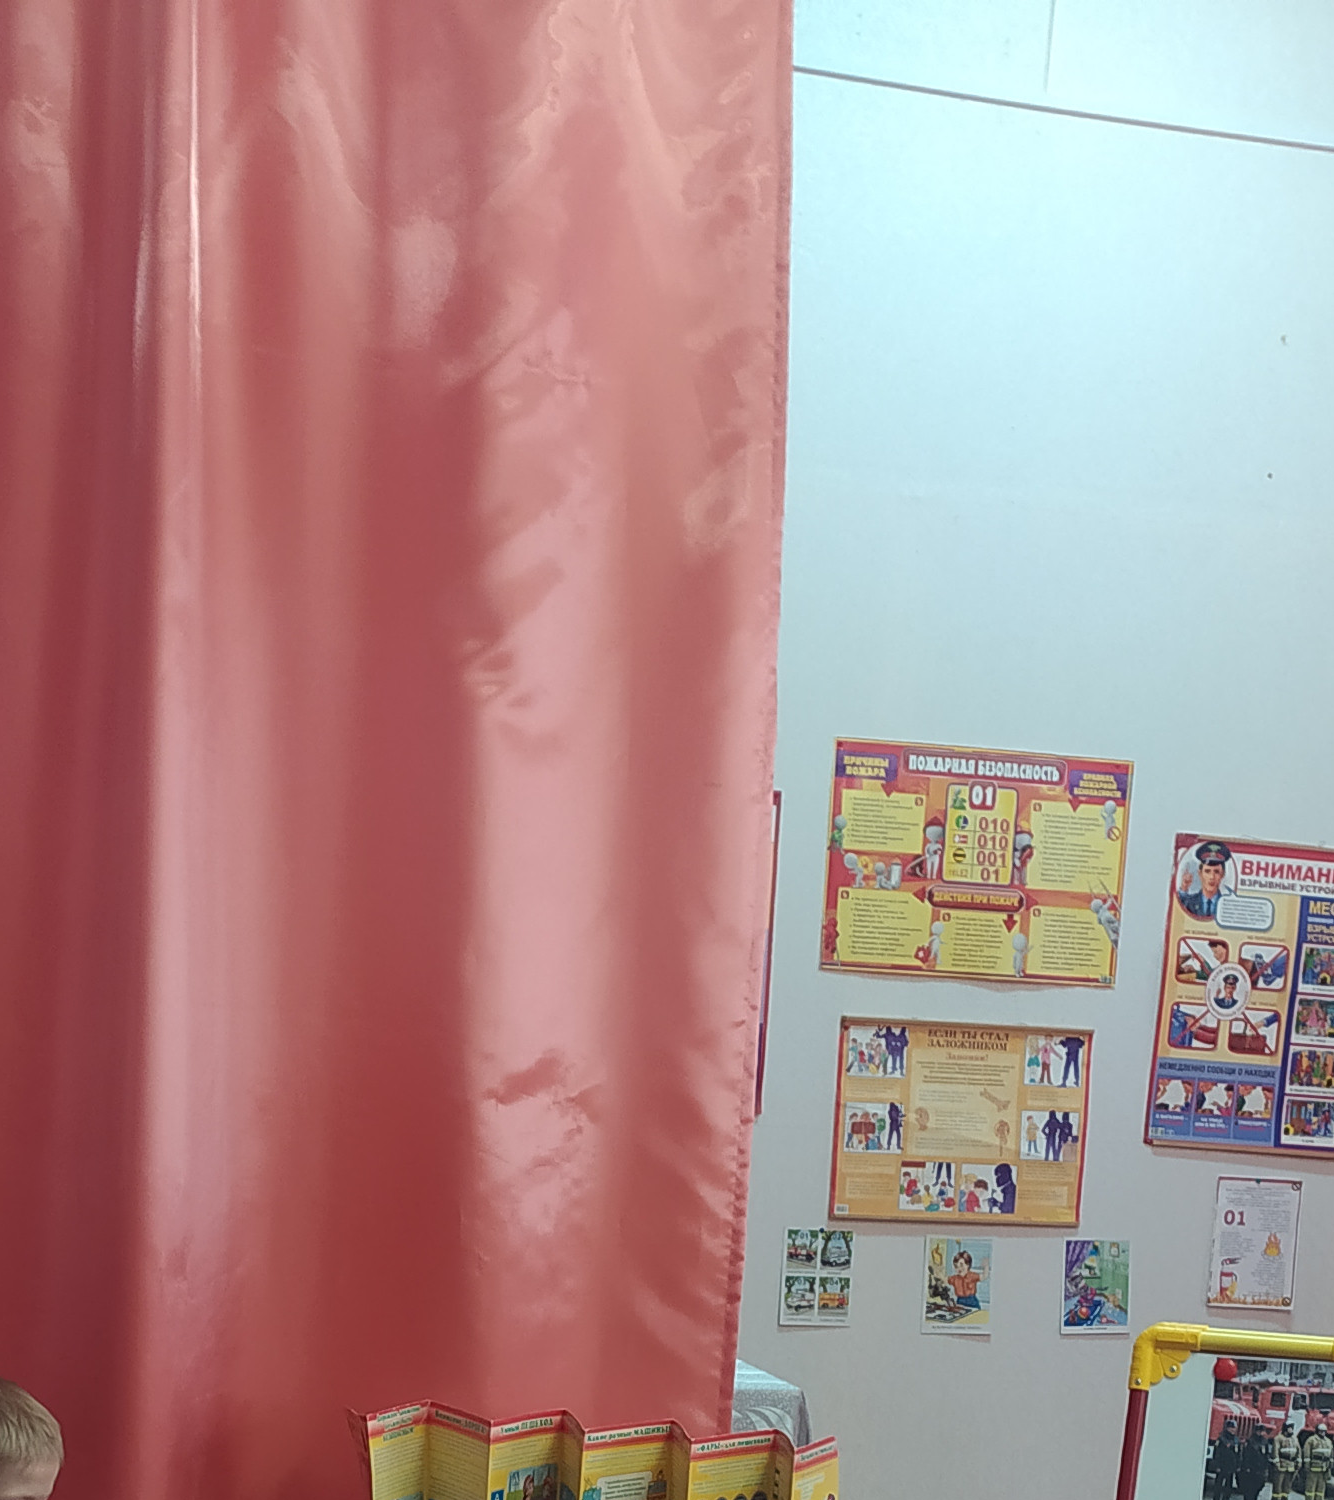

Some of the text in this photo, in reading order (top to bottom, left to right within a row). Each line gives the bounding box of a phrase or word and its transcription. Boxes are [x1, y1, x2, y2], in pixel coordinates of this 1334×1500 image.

[909, 755, 1060, 782] ПОЖАРНАЯ БЕЗОПАСНОСТЬ
[972, 785, 993, 806] 01
[979, 816, 1010, 834] 010
[977, 834, 1008, 850] 010
[977, 850, 1007, 868] 001
[981, 868, 1000, 882] 01
[1240, 878, 1298, 892] ВЗРЫВНЫЕ
[928, 1028, 1010, 1042] ЕСЛИ ТЫ СТАЛ
[927, 1039, 1008, 1051] ЗАЛОЖНИКОМ
[1224, 1209, 1246, 1226] 01
[521, 1418, 553, 1430] ПЕШЕХОД
[587, 1434, 607, 1442] Какие
[609, 1431, 632, 1441] разные
